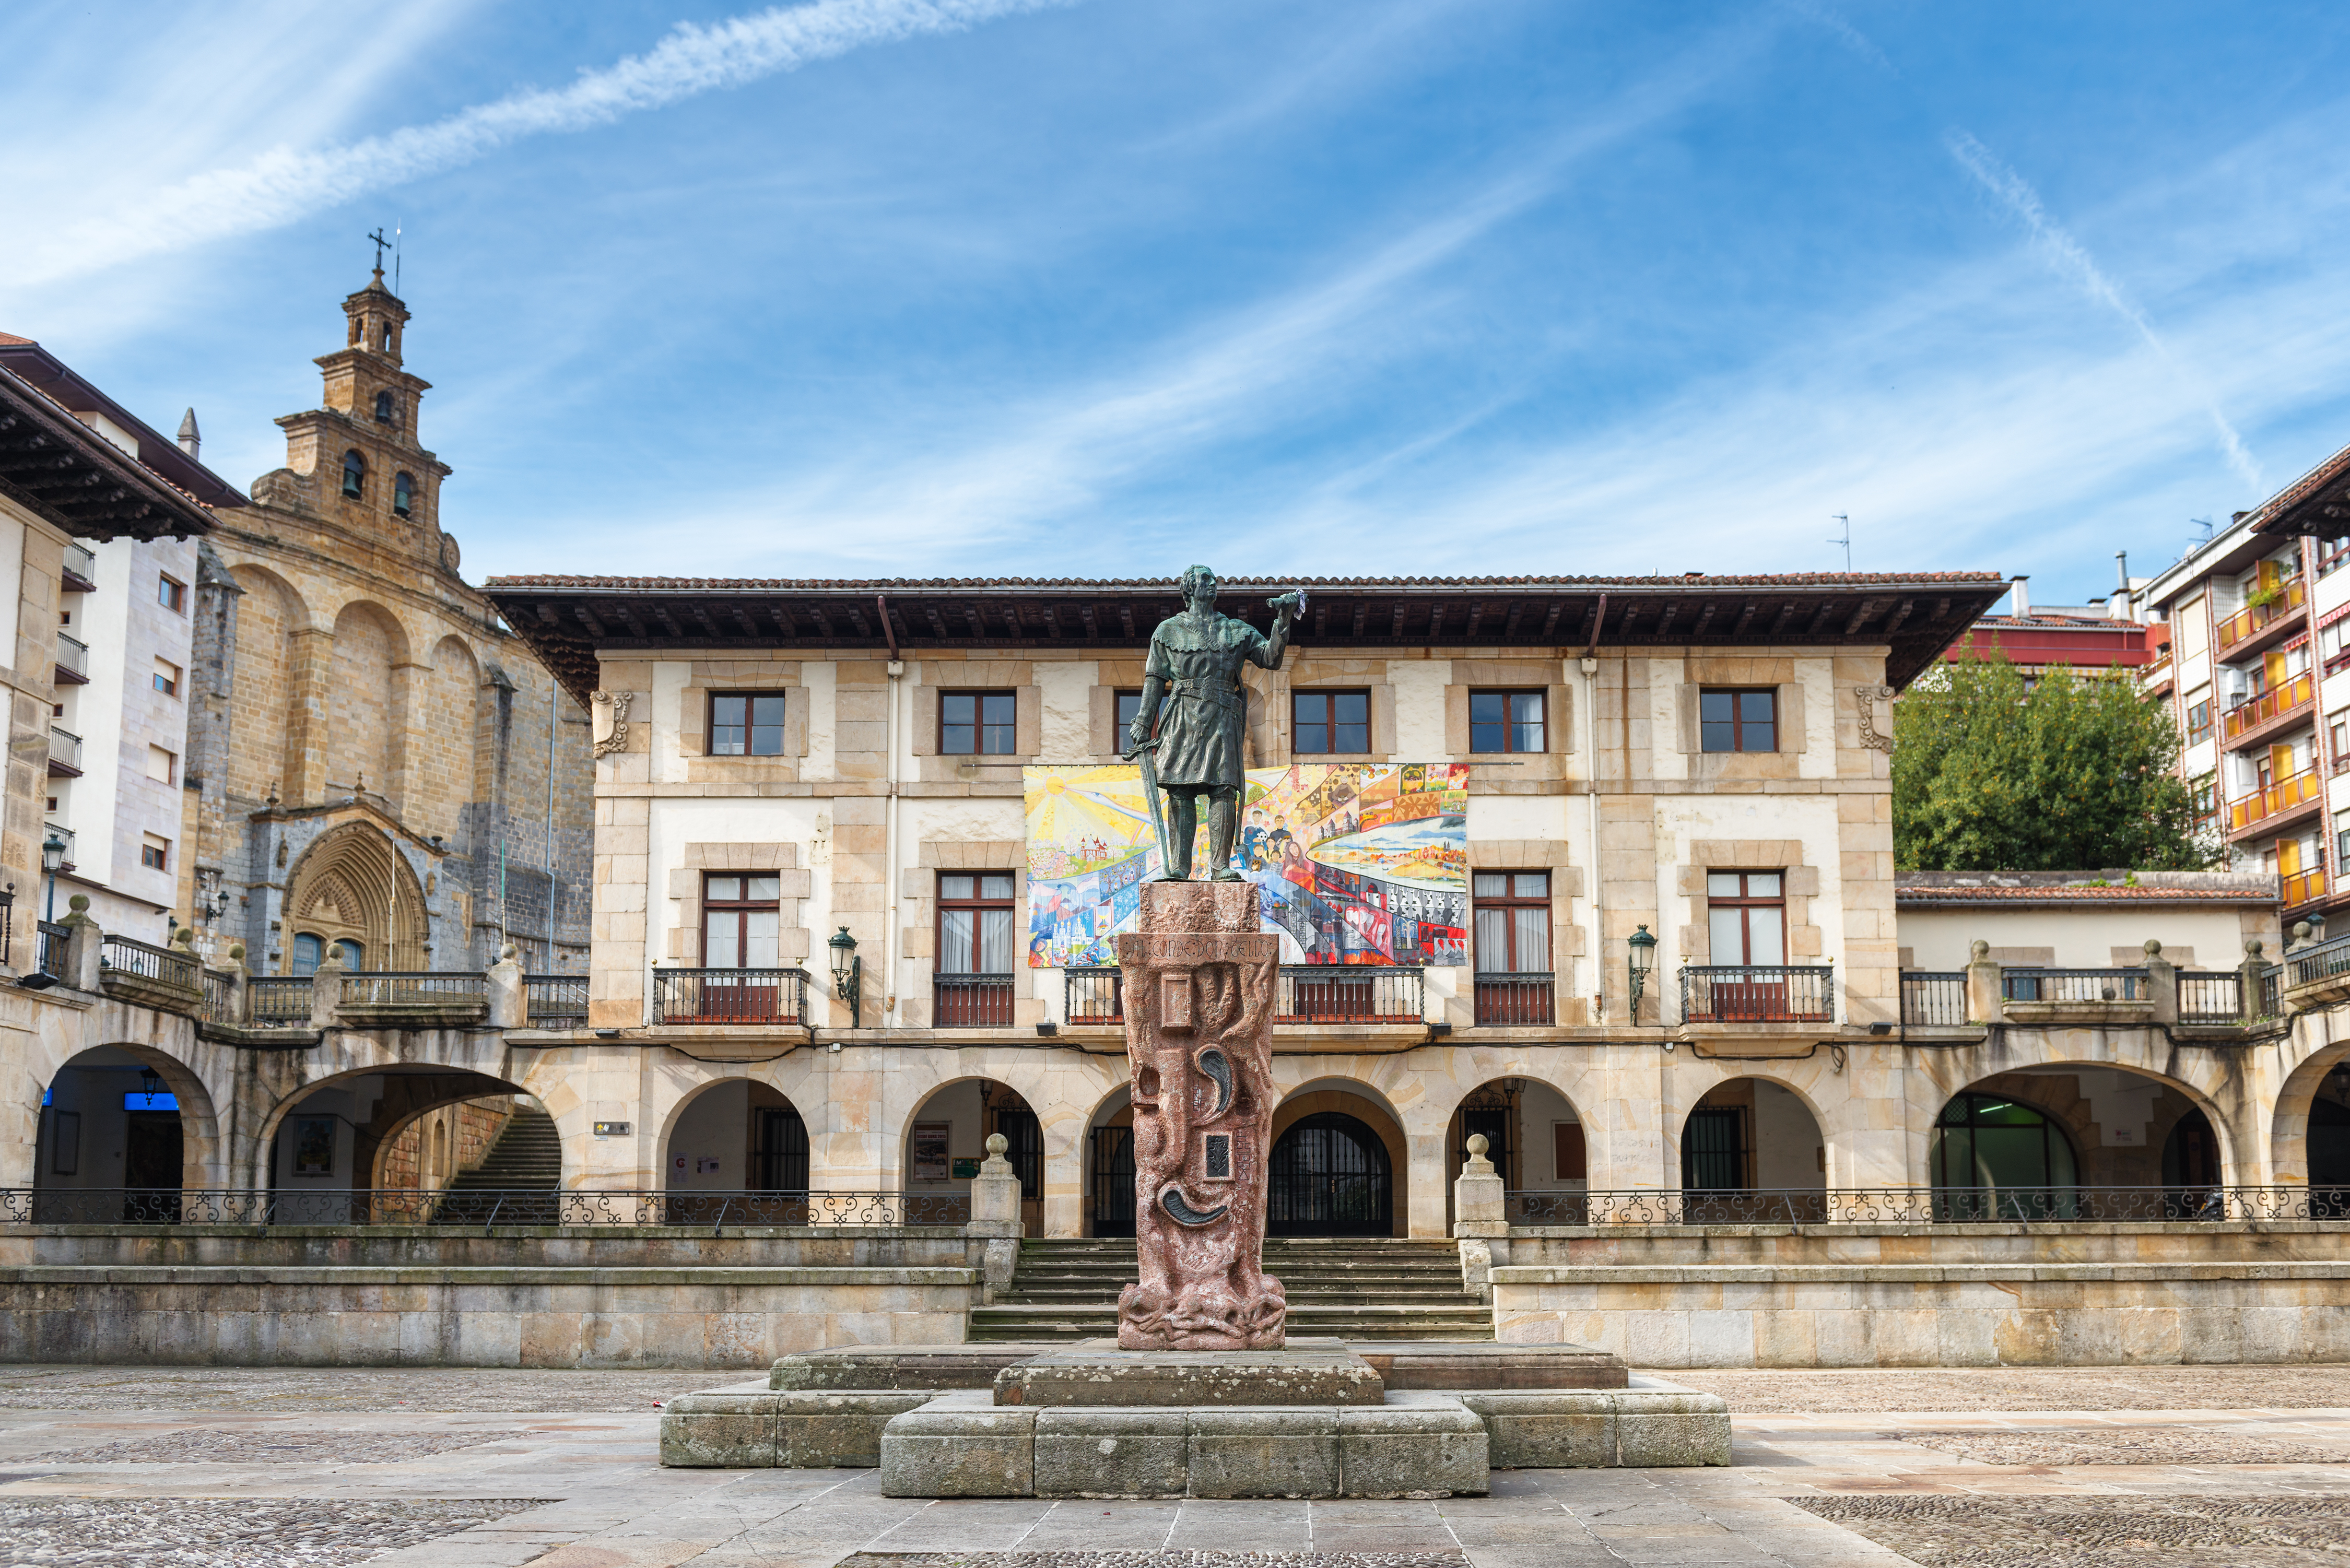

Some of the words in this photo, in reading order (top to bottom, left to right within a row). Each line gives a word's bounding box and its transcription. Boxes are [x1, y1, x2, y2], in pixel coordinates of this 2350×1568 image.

[1152, 940, 1191, 957] CONDE
[1197, 940, 1223, 957] DON
[1230, 940, 1269, 957] TELLO
[676, 1158, 685, 1168] G
